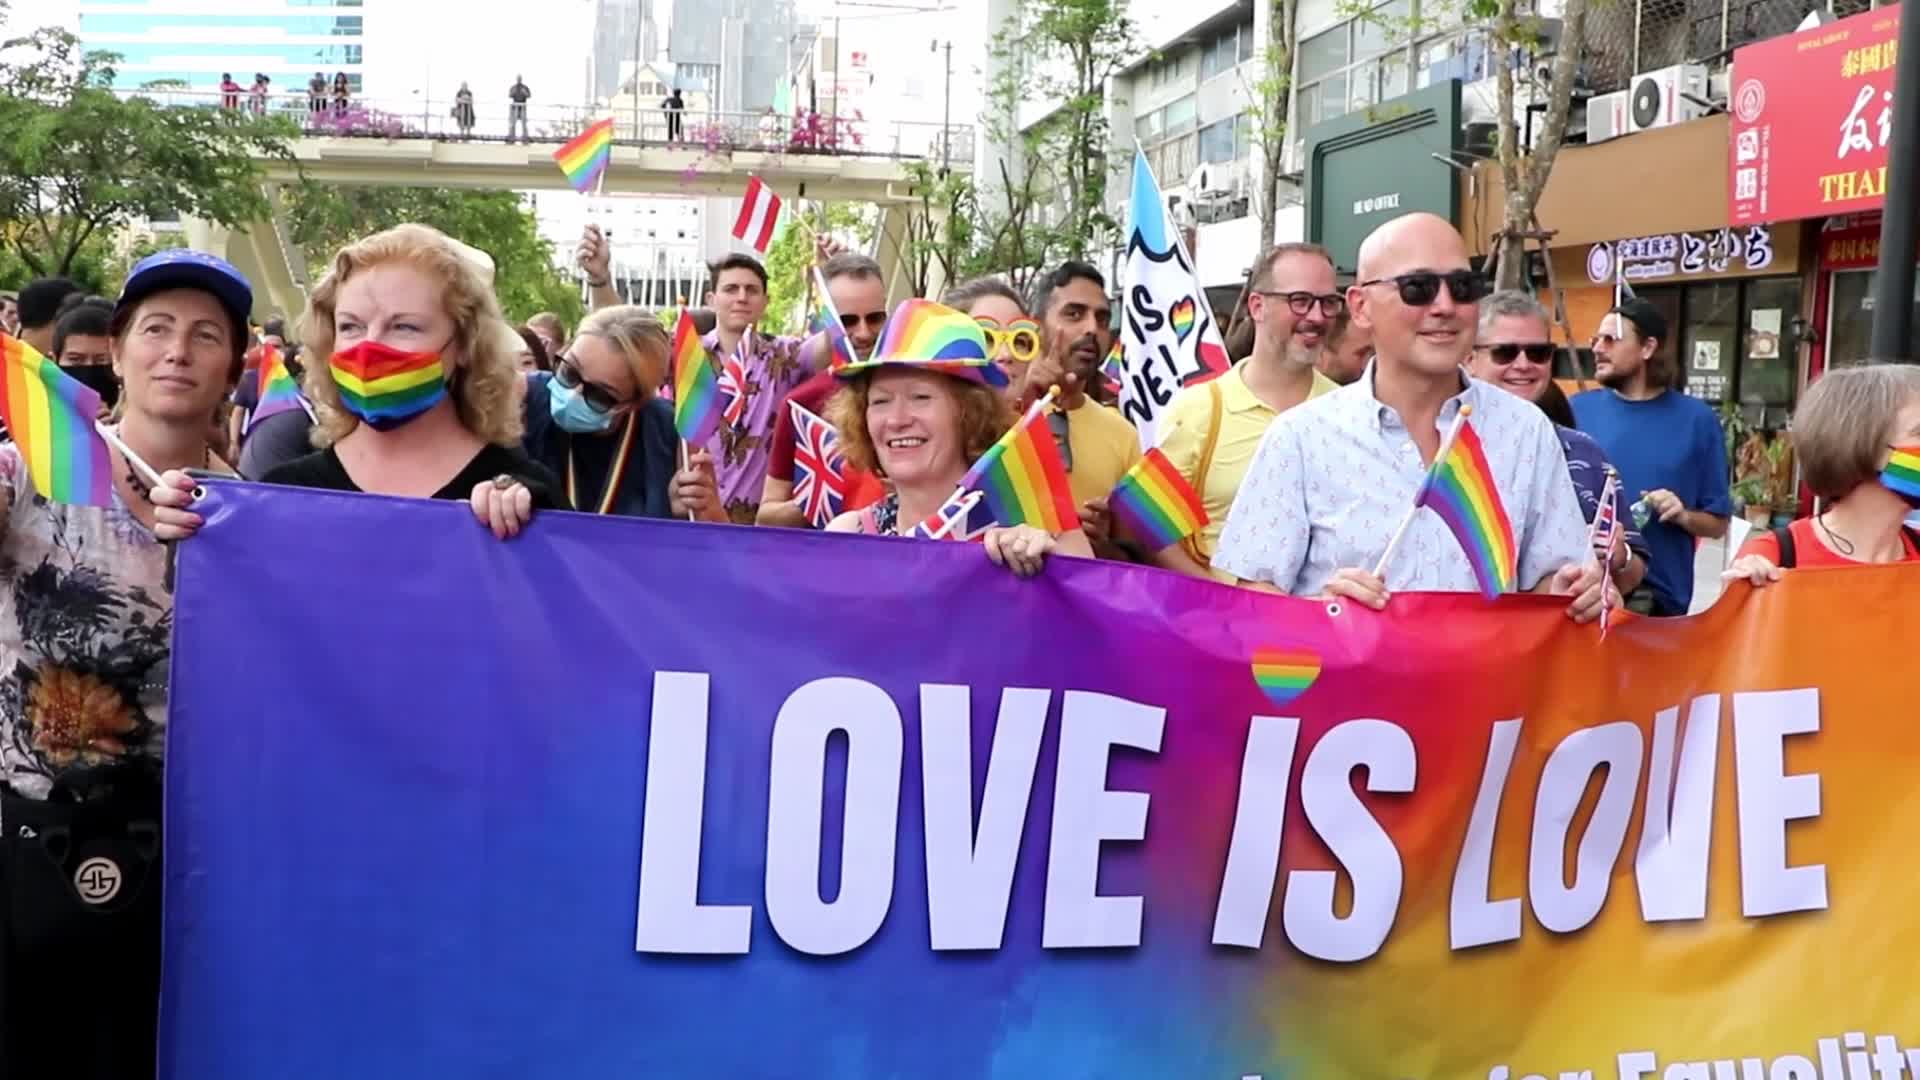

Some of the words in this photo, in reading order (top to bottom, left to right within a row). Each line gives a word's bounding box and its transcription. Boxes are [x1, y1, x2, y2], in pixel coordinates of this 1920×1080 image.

[1374, 193, 1400, 211] OFFICE
[1126, 284, 1164, 344] IS
[635, 670, 1168, 956] LOVE
[1211, 714, 1418, 962] IS
[1450, 687, 1829, 951] LOVE
